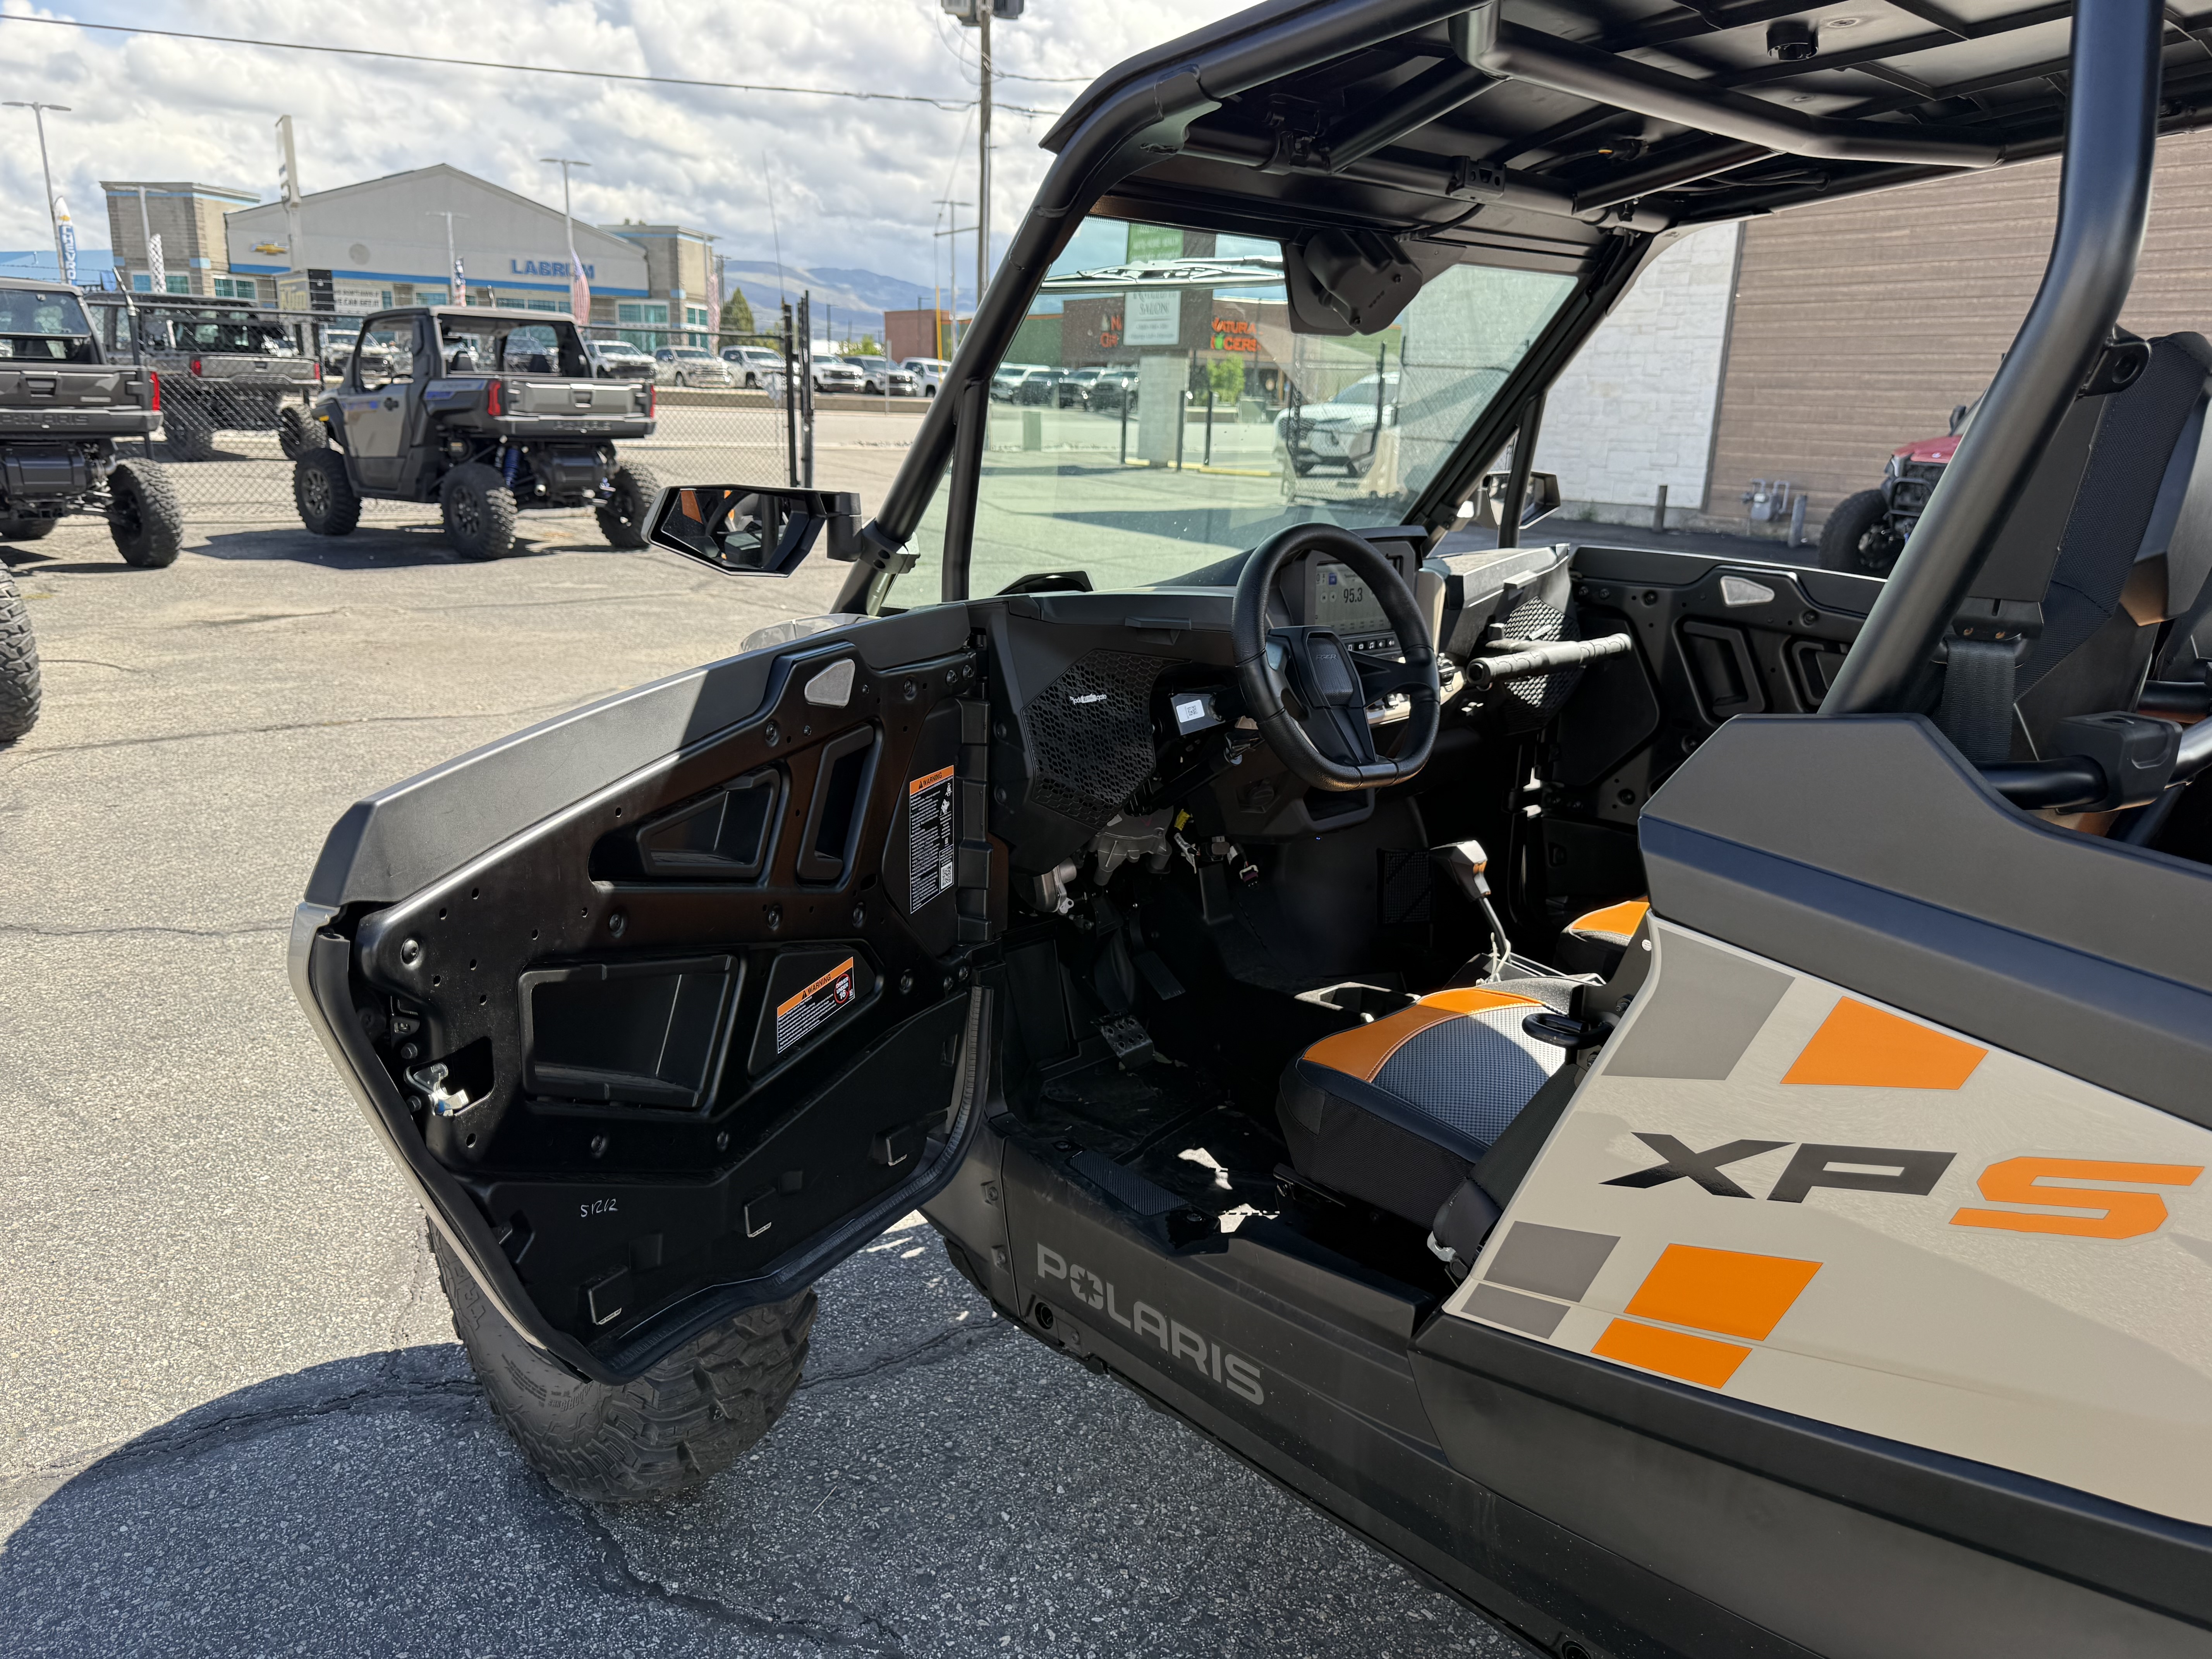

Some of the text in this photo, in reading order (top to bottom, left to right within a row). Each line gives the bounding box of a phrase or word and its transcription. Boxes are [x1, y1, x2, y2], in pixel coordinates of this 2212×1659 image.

[1343, 587, 1363, 603] 95.3
[923, 772, 942, 786] WARNING
[807, 974, 831, 994] WARNING
[836, 982, 848, 994] UNDER
[839, 990, 846, 1000] 16
[1037, 1242, 1264, 1405] POLARIS
